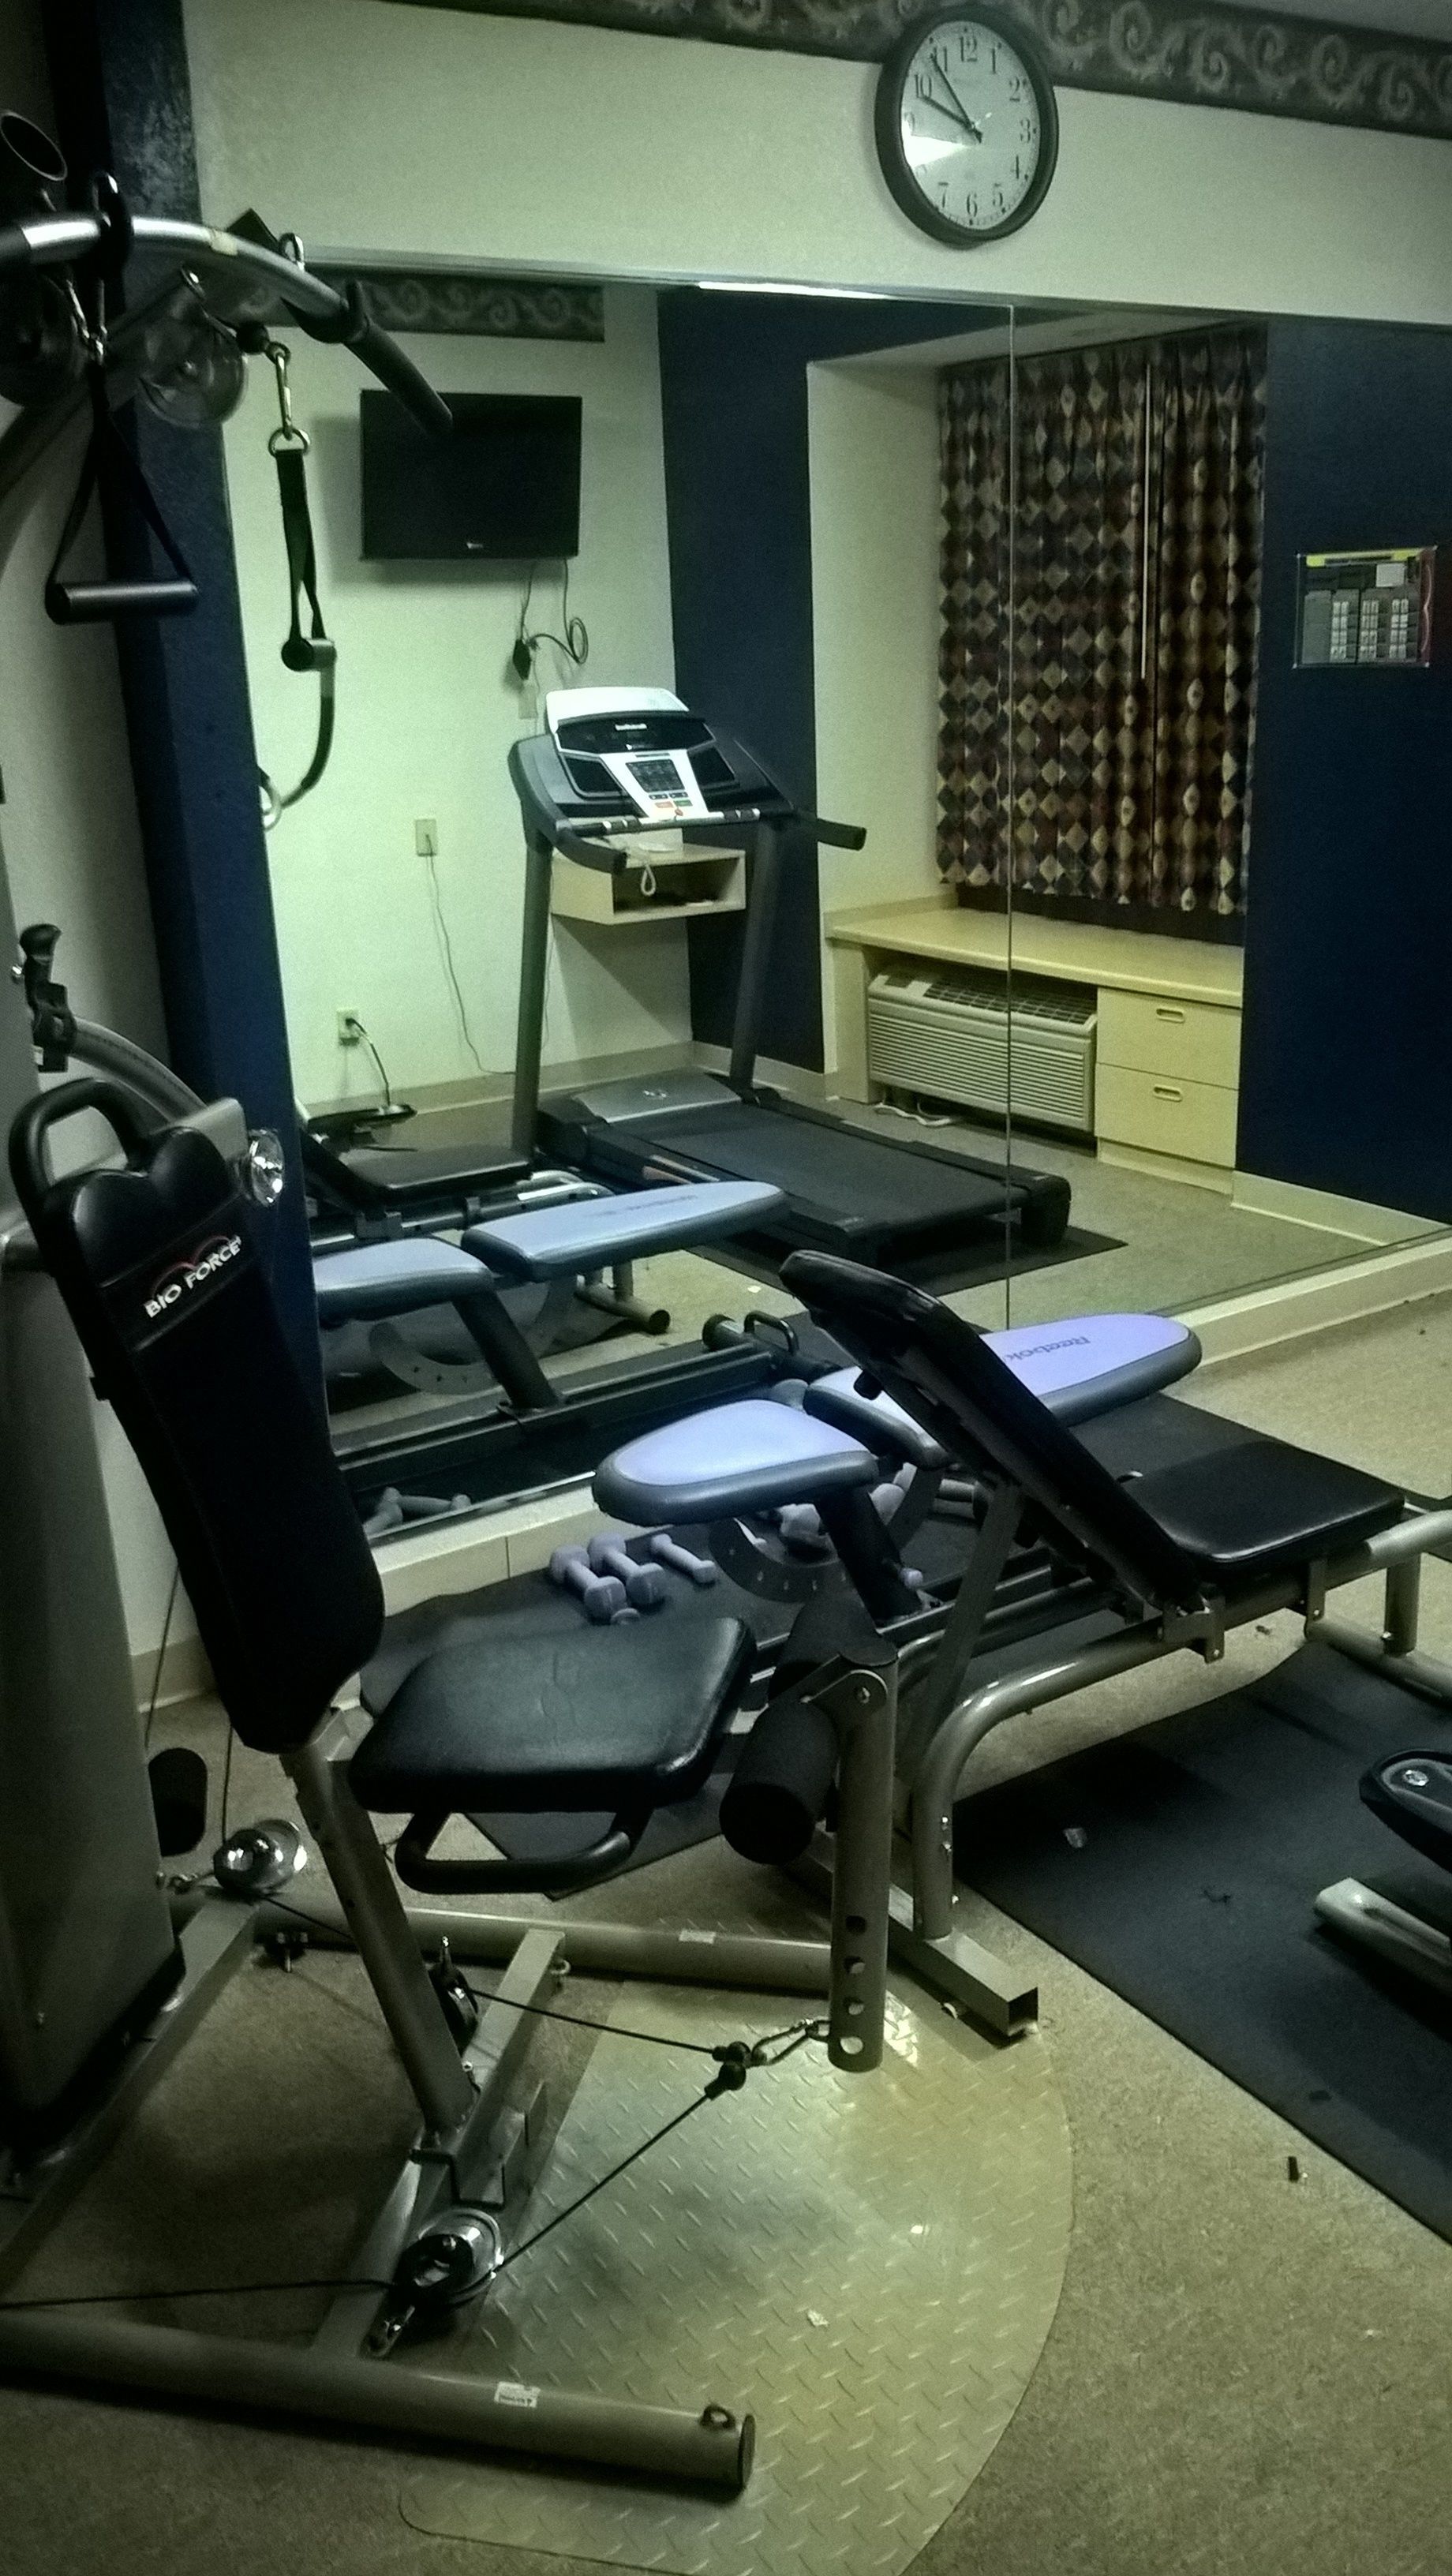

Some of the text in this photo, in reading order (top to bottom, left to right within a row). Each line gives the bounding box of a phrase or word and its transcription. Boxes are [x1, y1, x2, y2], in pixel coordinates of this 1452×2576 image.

[960, 36, 978, 62] 12
[991, 47, 997, 74] 1
[914, 73, 933, 99] 10
[1009, 77, 1020, 102] 2
[1020, 119, 1031, 142] 3
[1010, 155, 1020, 179] 4
[937, 182, 949, 208] 7
[966, 193, 979, 218] 6
[992, 183, 1004, 208] 5
[144, 1234, 241, 1318] BIO FORCE
[1005, 1335, 1091, 1361] Reebok
